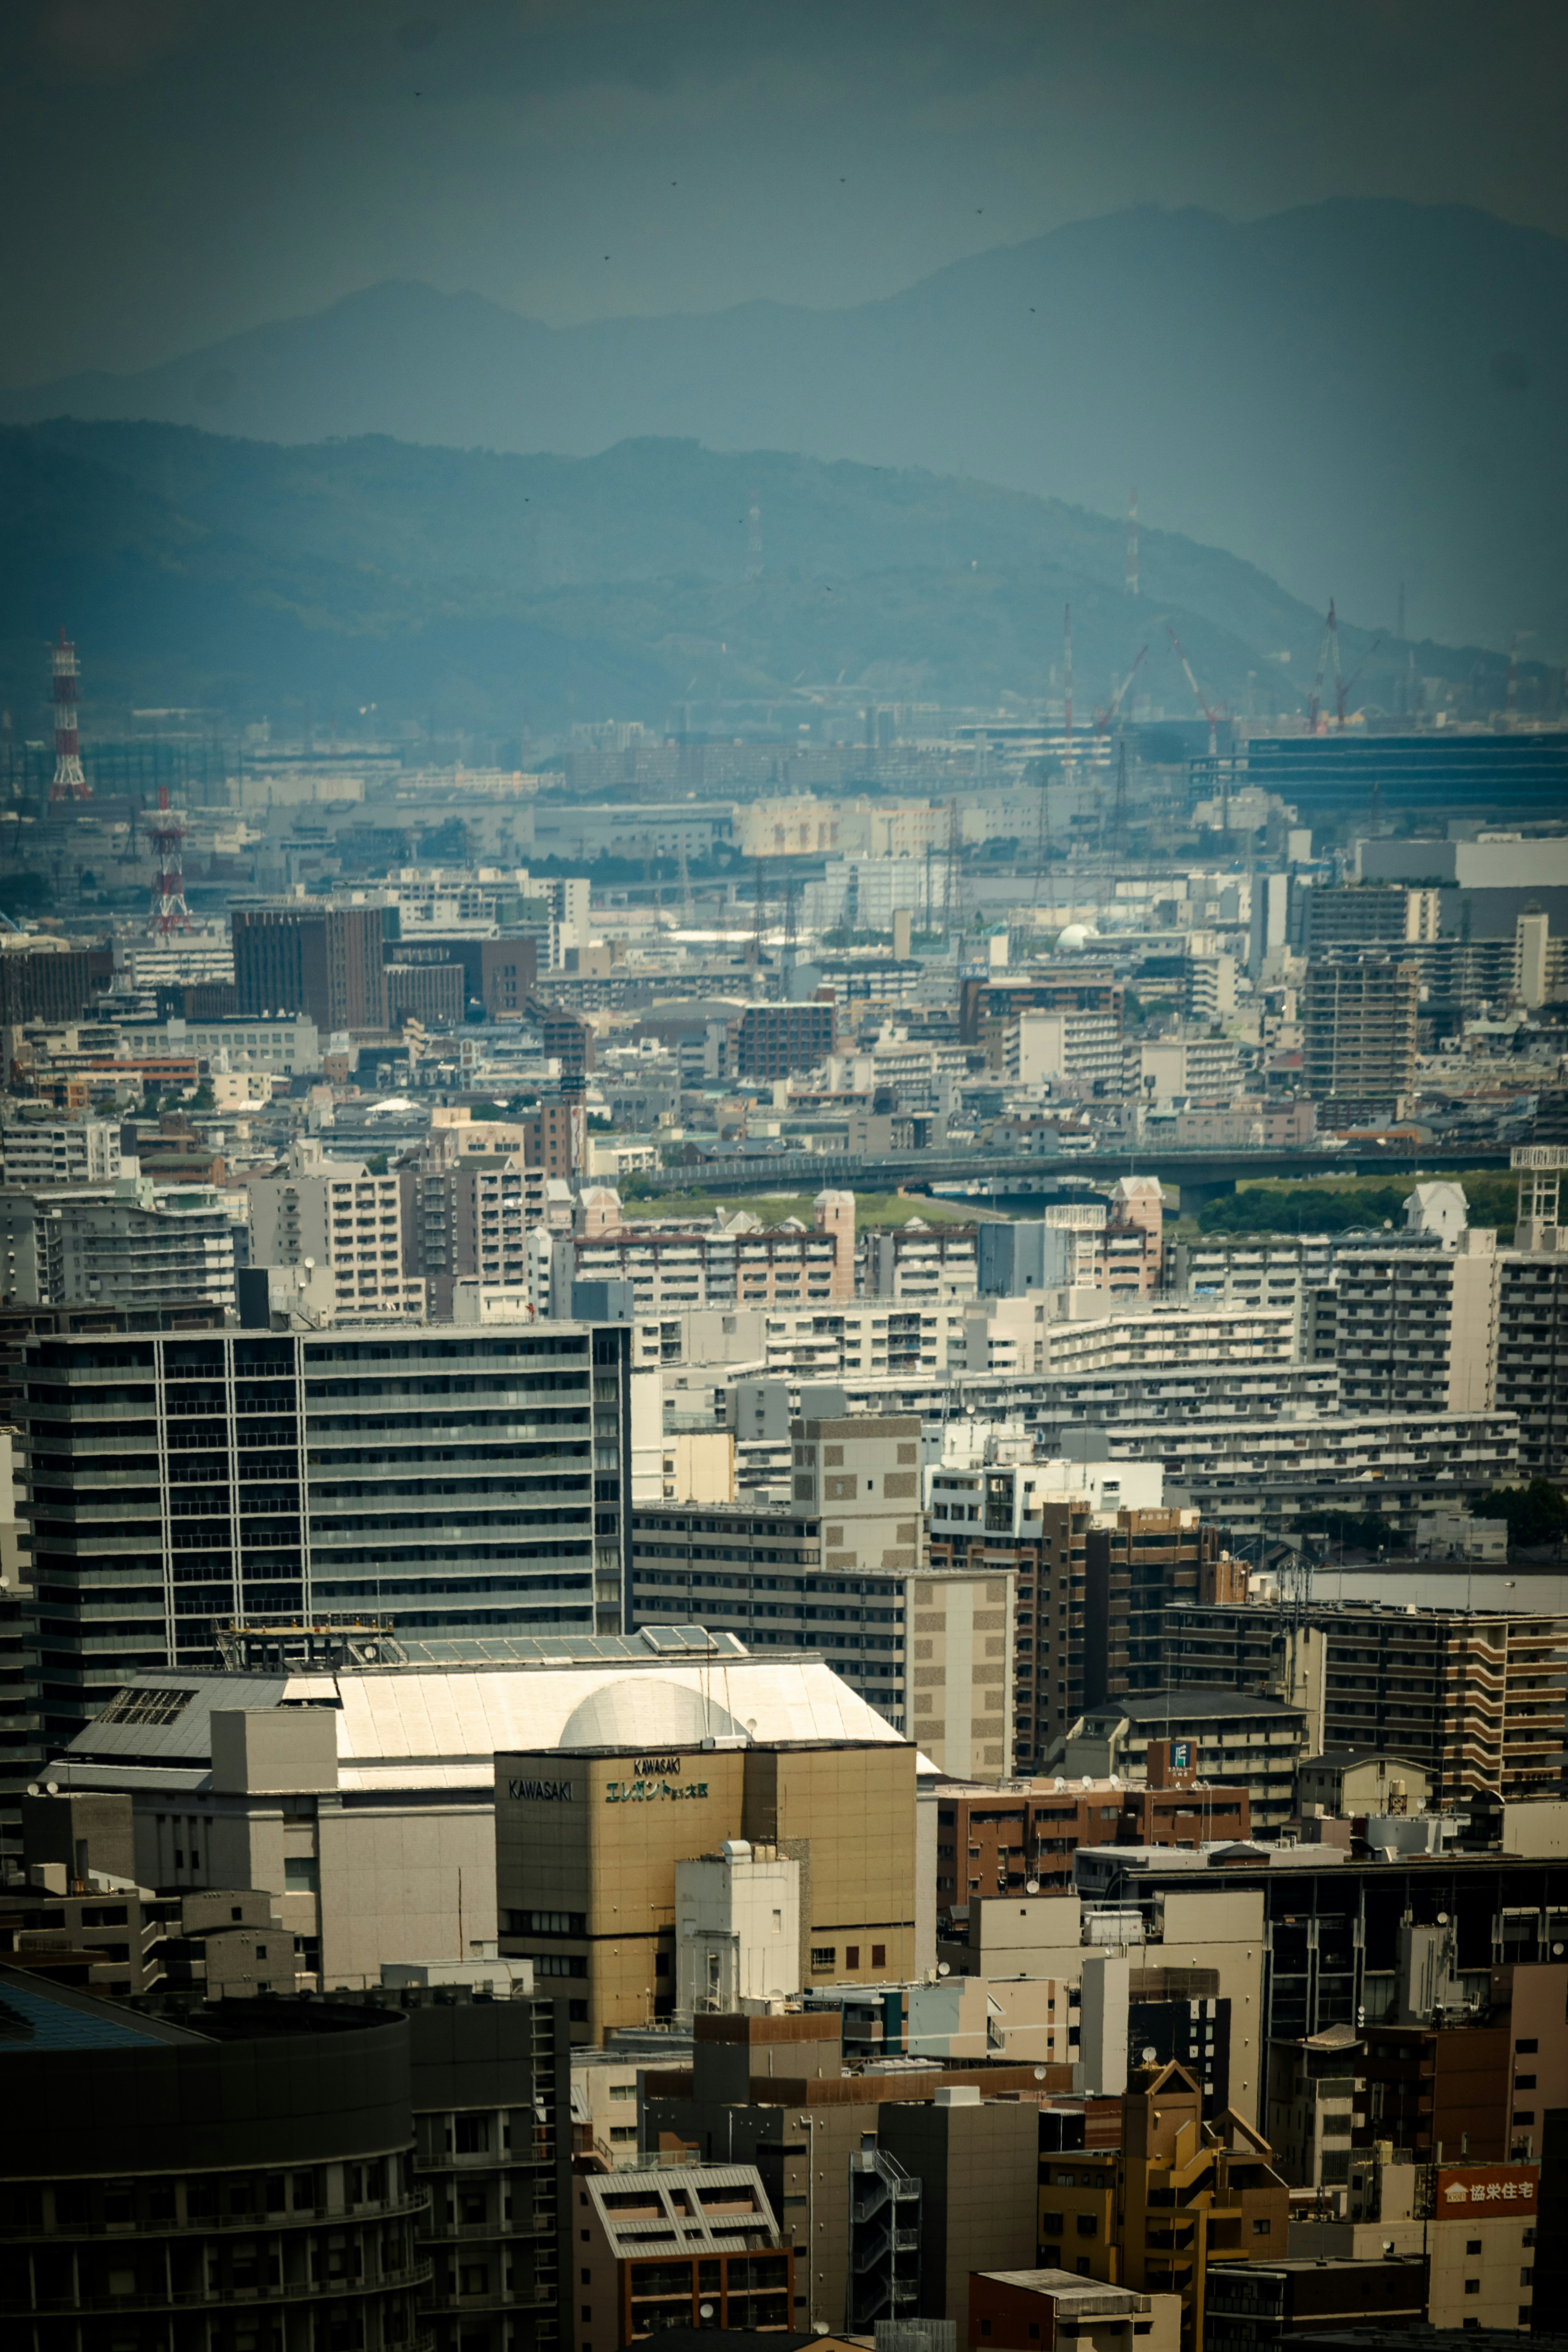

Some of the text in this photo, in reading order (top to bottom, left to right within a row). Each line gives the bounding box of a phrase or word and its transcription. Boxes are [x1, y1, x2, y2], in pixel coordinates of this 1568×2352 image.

[634, 1757, 681, 1775] KAWASAKI
[508, 1780, 573, 1801] KAWASAKI
[1470, 2181, 1533, 2202] 協栄住宅
